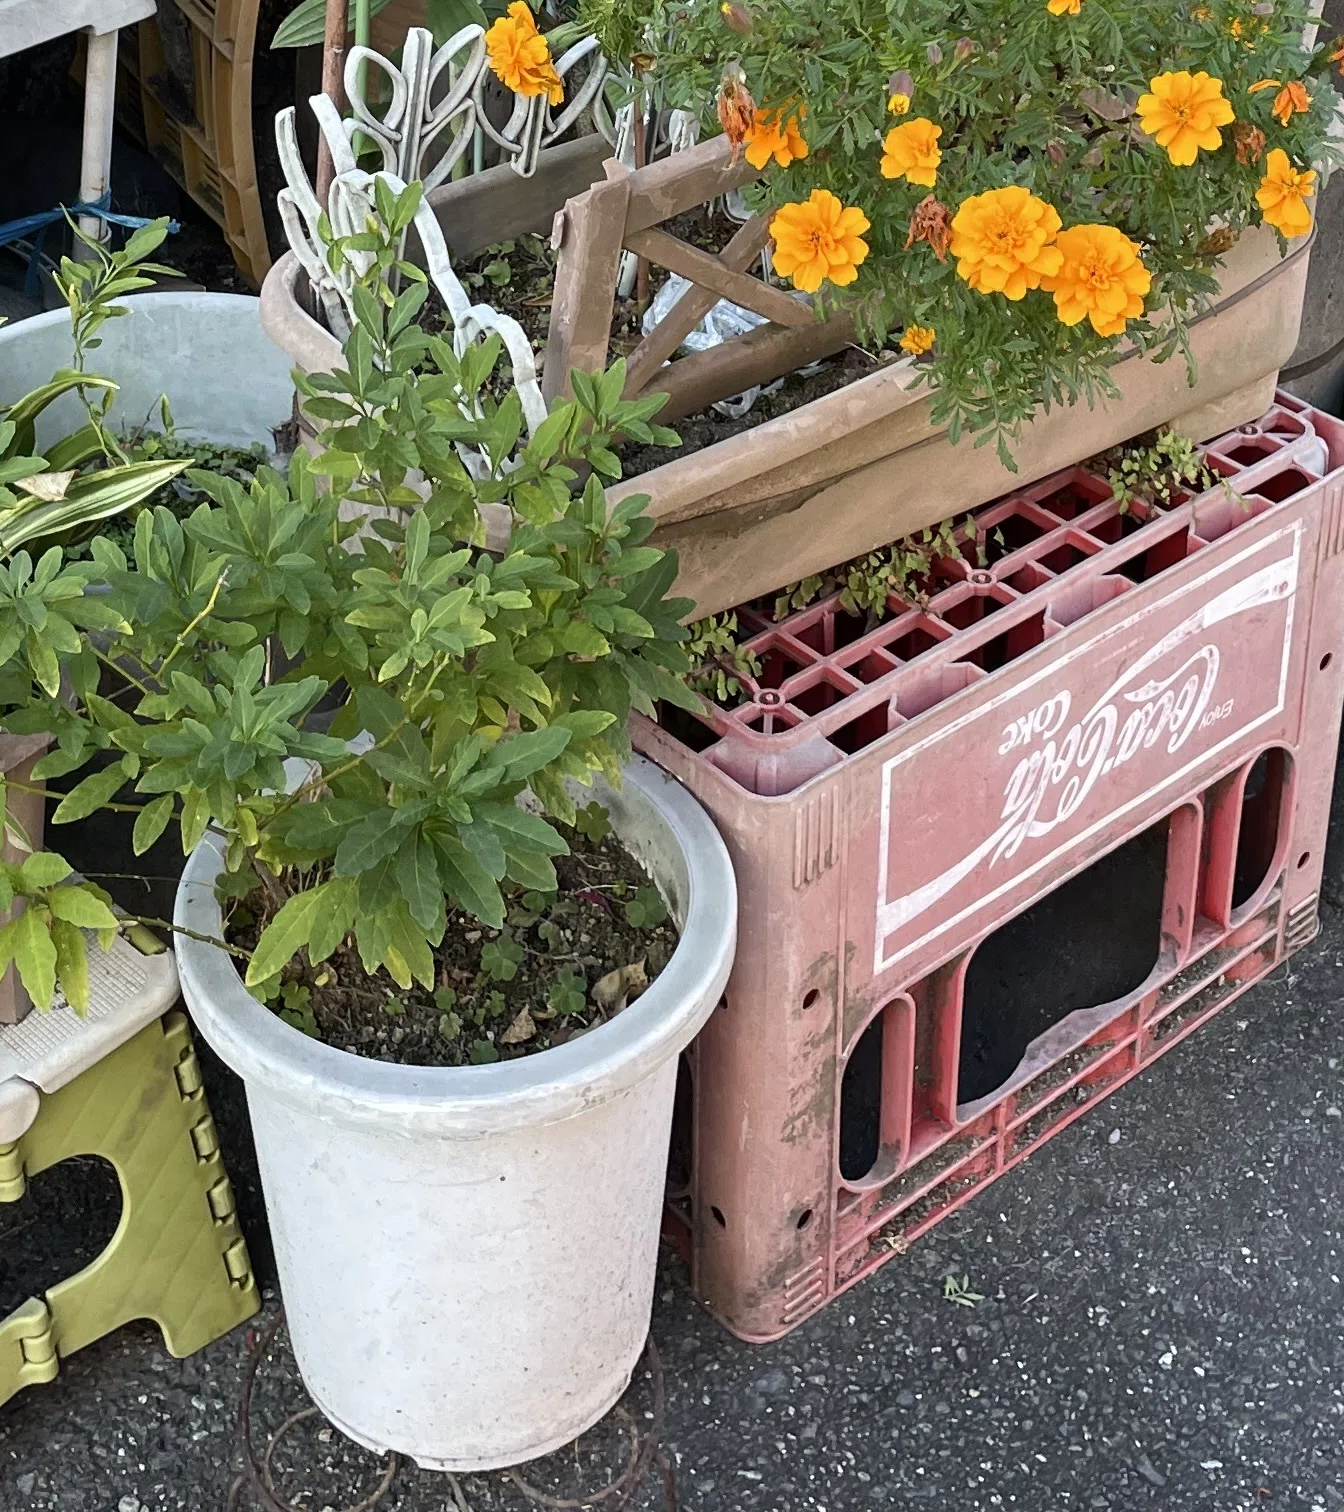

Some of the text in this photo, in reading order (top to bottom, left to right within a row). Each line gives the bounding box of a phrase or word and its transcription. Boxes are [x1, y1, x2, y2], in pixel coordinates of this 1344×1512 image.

[994, 644, 1234, 862] Enjoy Coca-Cola
[999, 689, 1072, 755] Coke
